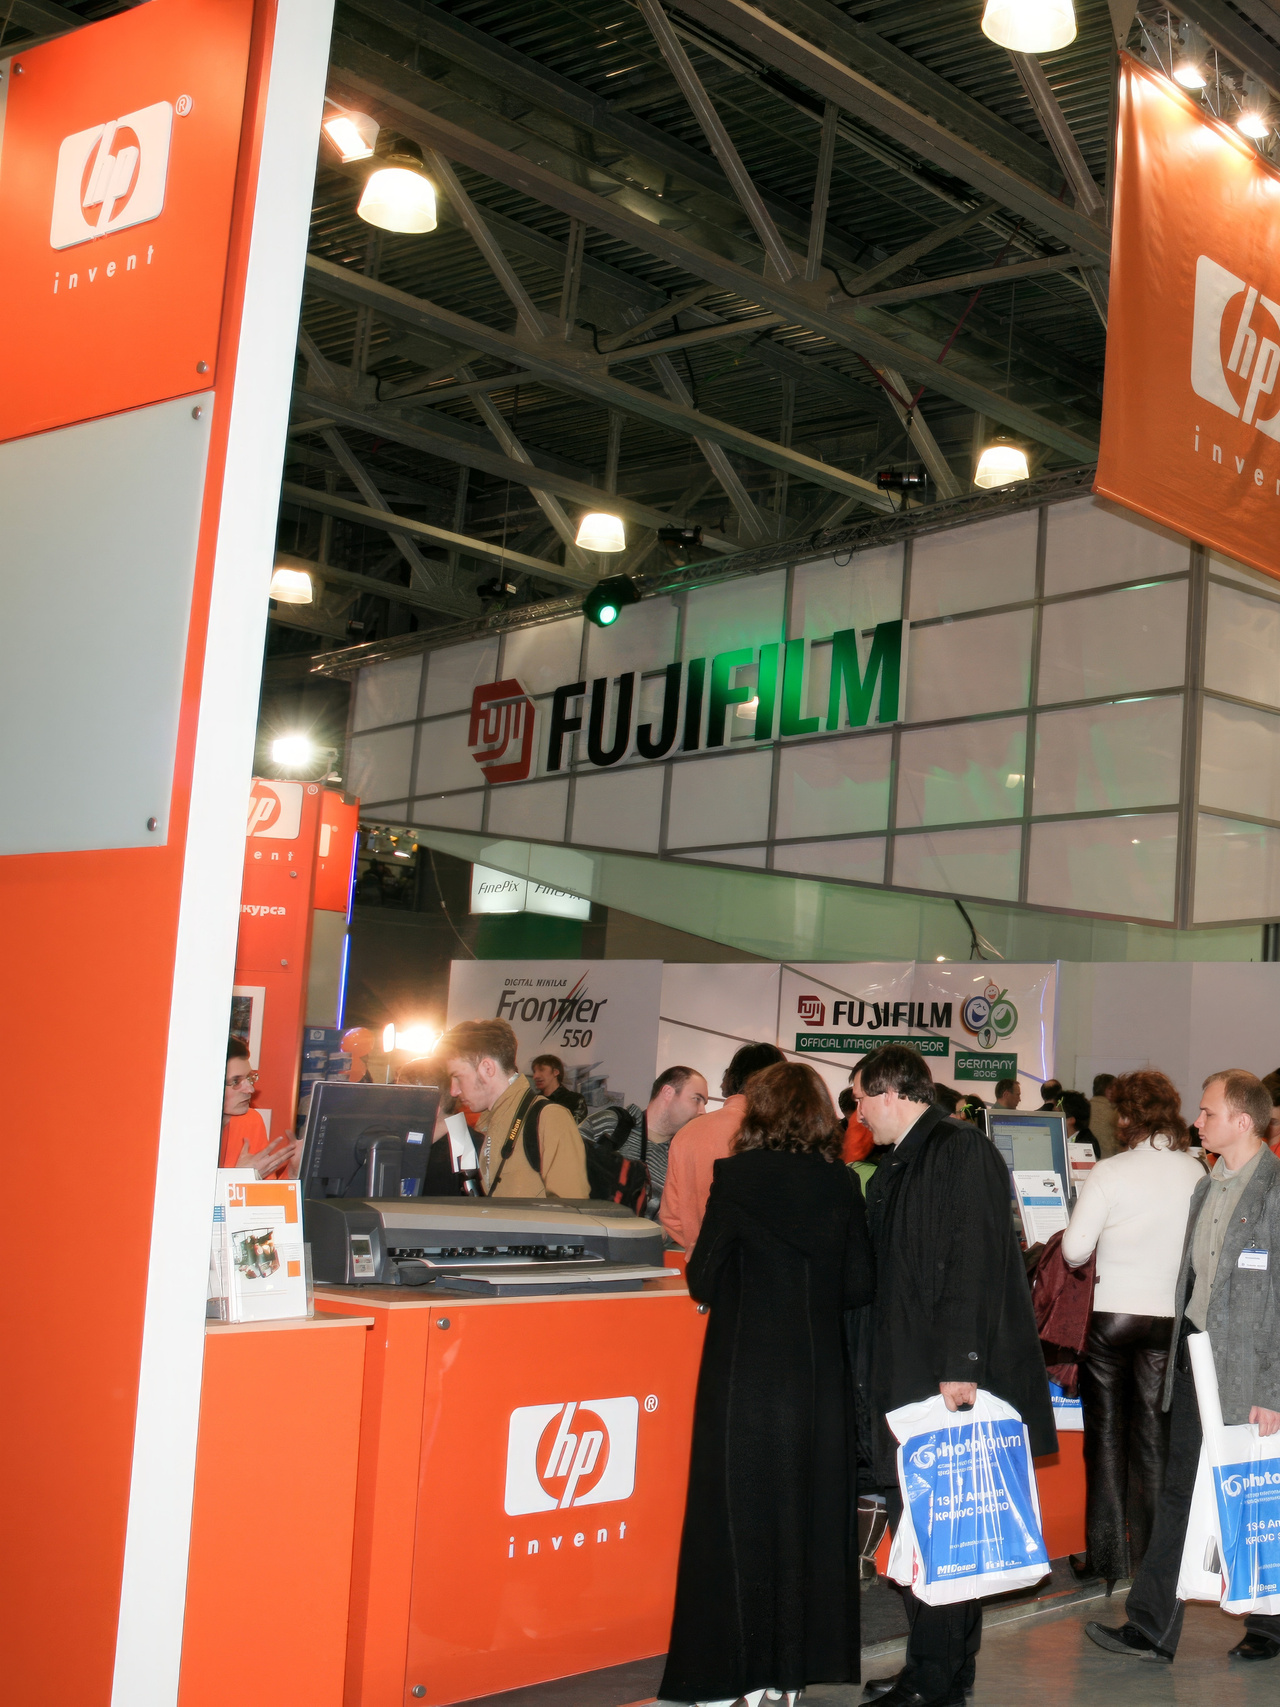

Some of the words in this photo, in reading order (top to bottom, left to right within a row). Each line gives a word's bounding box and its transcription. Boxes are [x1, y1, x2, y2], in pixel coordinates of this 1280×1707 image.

[53, 245, 154, 294] invent
[546, 619, 906, 772] FUJIFILM
[477, 880, 520, 895] FinePix
[504, 978, 534, 987] DIGITAL
[536, 979, 568, 987] MINILAB
[495, 989, 608, 1023] Frontier
[832, 1000, 953, 1030] FUJIFILM
[560, 1029, 593, 1048] 550
[800, 1037, 841, 1049] OFFICIAL
[957, 1058, 1015, 1071] GERMANY
[973, 1070, 997, 1078] 2006
[510, 1118, 521, 1140] Nikon
[936, 1435, 1021, 1459] photoforum
[508, 1522, 627, 1558] invent
